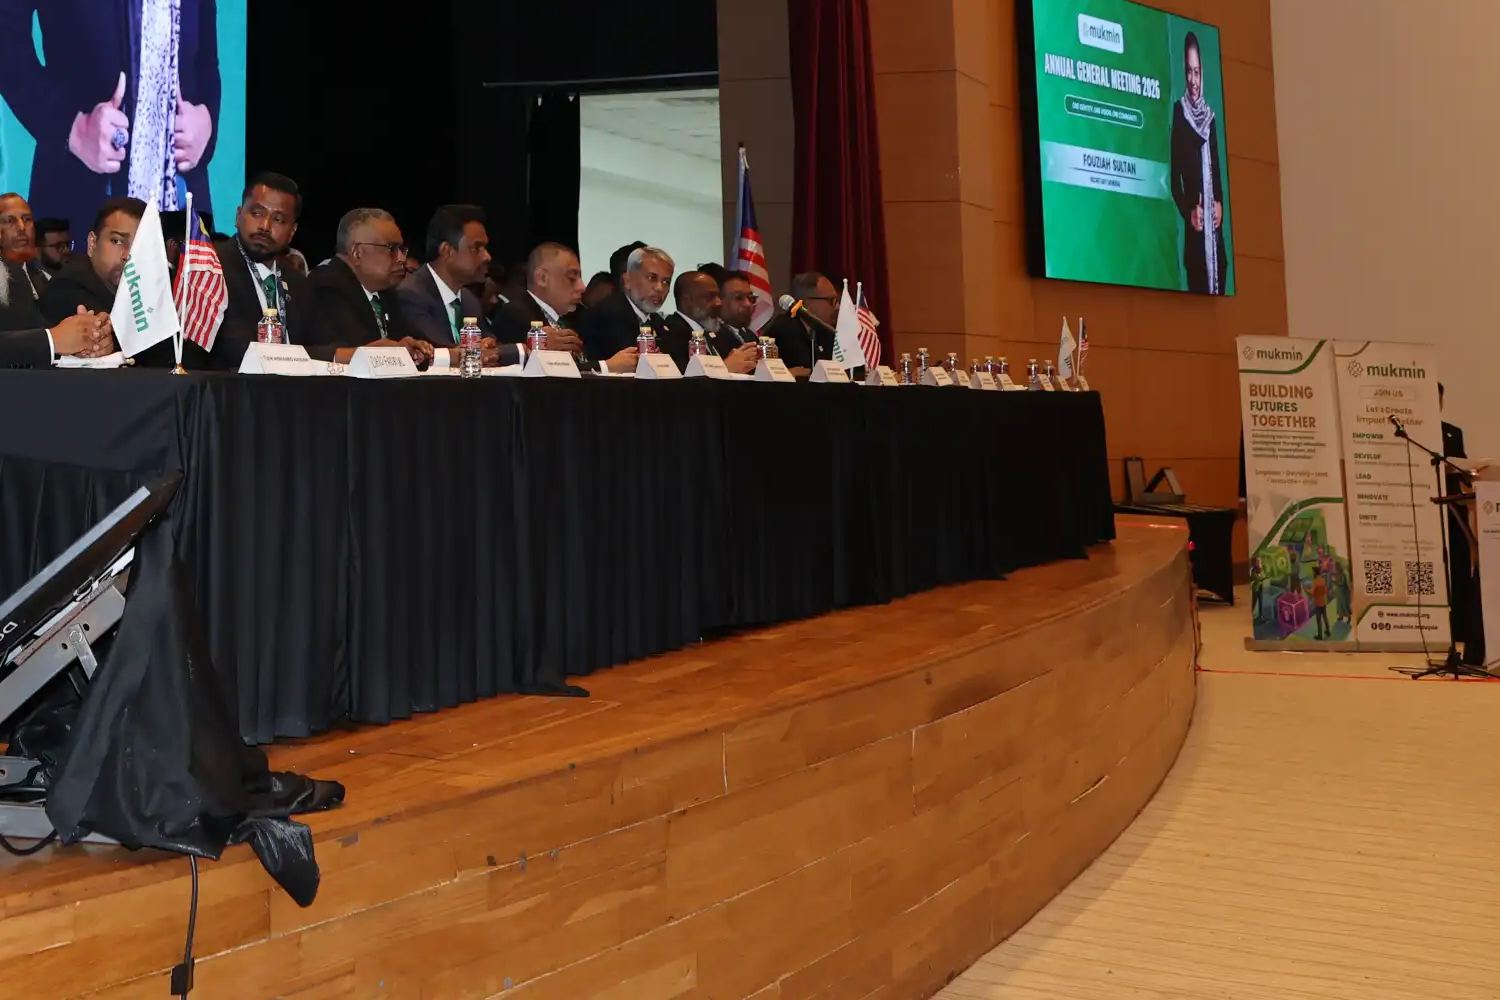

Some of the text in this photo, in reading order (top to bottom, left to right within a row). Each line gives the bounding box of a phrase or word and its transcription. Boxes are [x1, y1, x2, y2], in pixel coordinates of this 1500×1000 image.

[1089, 24, 1121, 44] mukmin
[1044, 52, 1161, 100] ANNUAL GENERAL MEETING 2026
[1083, 153, 1137, 176] FOUZIAH SULTAN
[123, 254, 153, 332] ukmin
[1256, 345, 1303, 361] mukmin
[1366, 361, 1426, 379] mukmin
[1249, 383, 1314, 400] BUILDING
[1374, 388, 1403, 398] JOIN US
[1250, 400, 1298, 412] FUTURES
[1251, 414, 1316, 429] TOGETHER
